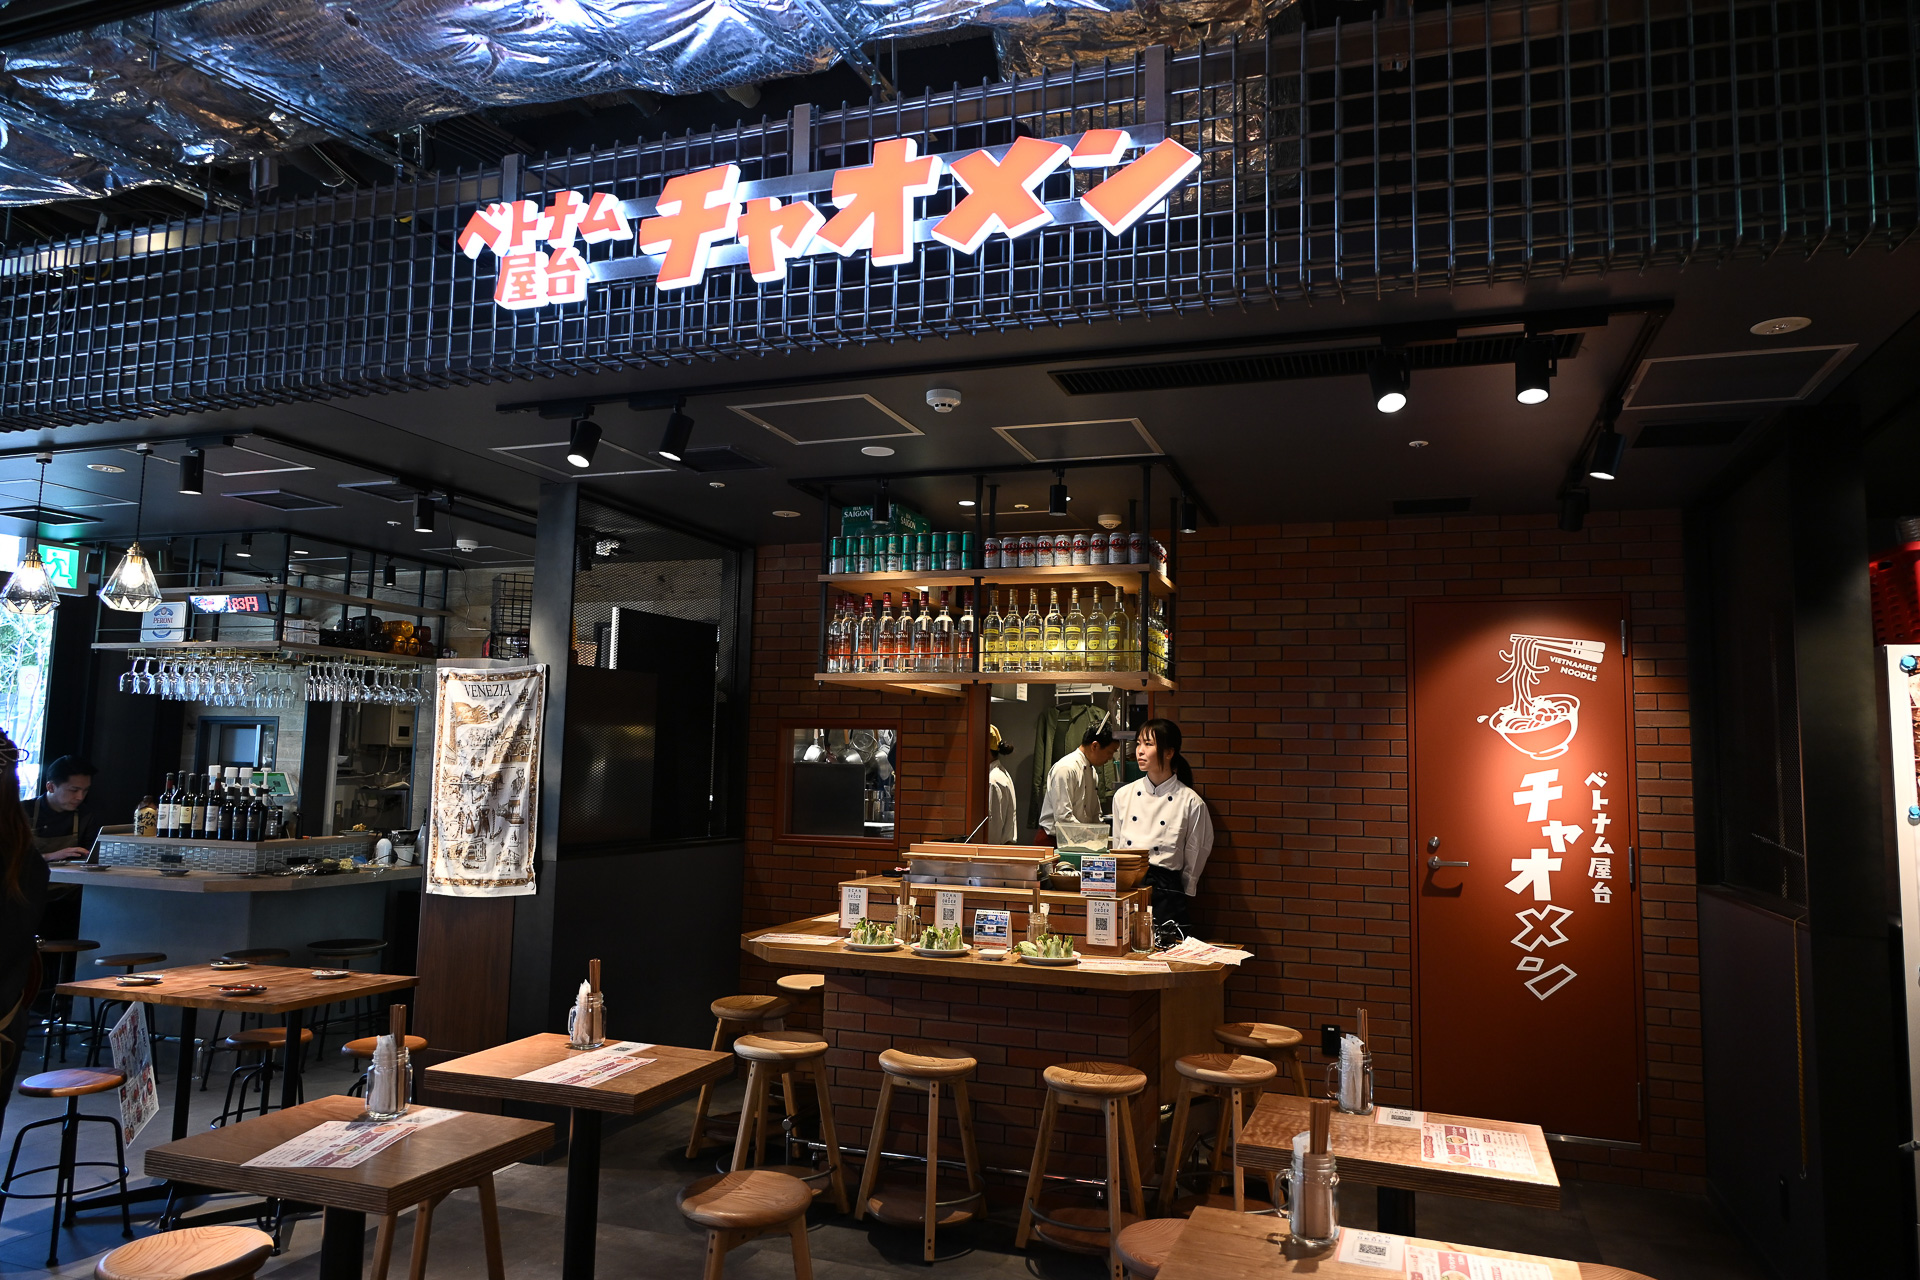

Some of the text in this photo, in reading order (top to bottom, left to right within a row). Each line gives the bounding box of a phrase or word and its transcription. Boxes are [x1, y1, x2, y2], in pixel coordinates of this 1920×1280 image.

[457, 190, 627, 258] ベトナム
[640, 128, 1200, 291] チャオメン
[494, 247, 582, 307] 屋台
[843, 510, 870, 518] SAIGON
[900, 516, 917, 530] SAIGON
[1550, 656, 1598, 673] VIETNAMESE
[1560, 666, 1598, 682] NOODLE
[464, 683, 511, 698] VENEZIA
[1583, 770, 1615, 904] ベトナム屋台
[1504, 768, 1584, 1001] チャオメン
